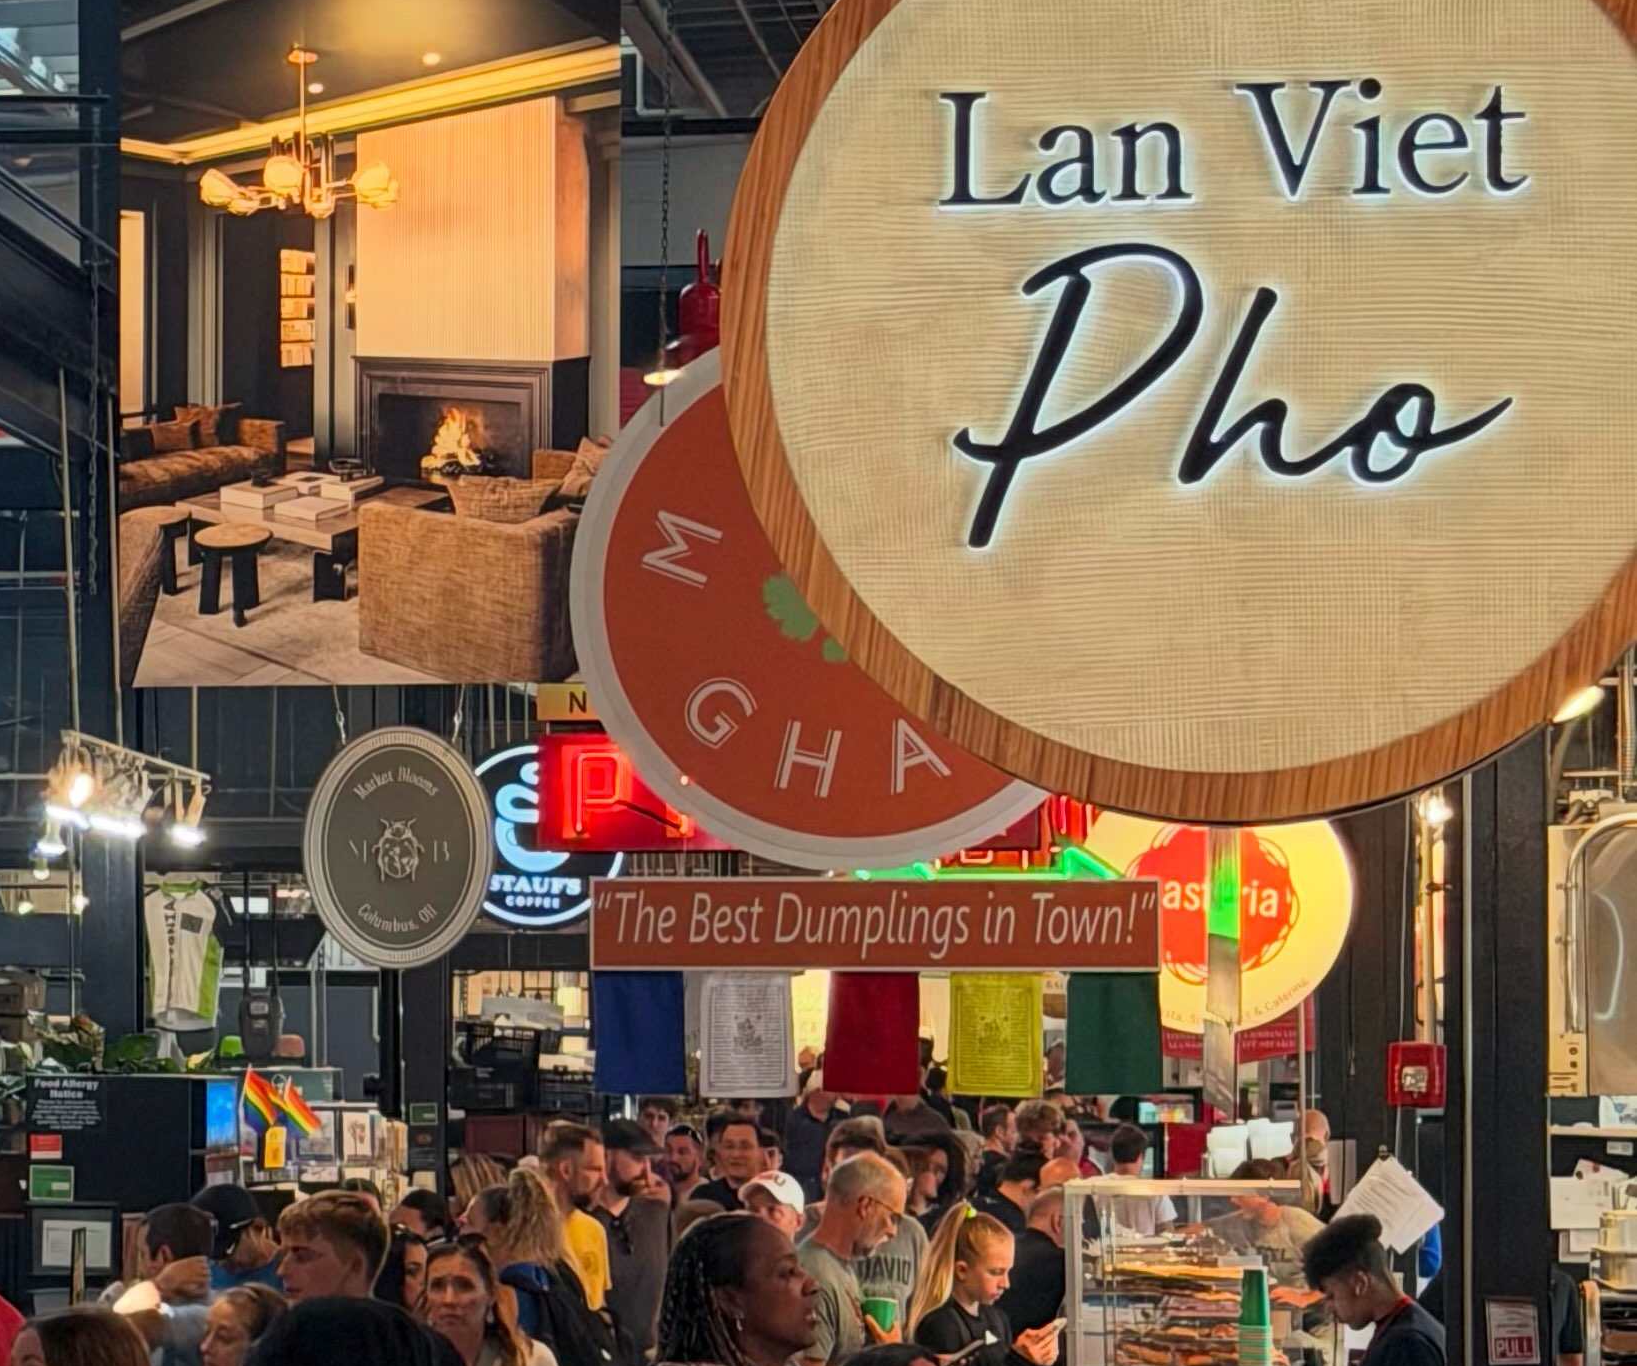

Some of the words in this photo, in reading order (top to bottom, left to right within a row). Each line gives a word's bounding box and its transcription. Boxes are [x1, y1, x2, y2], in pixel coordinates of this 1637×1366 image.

[937, 90, 1194, 209] Lan
[1232, 77, 1530, 201] Viet
[952, 242, 1515, 550] Pho
[683, 675, 952, 799] GHA
[352, 766, 395, 800] Market
[397, 765, 440, 797] Blooms
[504, 894, 561, 909] COFFEE
[689, 891, 763, 944] Best
[774, 890, 970, 960] Dumplings
[982, 889, 1016, 945] in
[34, 1078, 61, 1089] Food
[62, 1078, 100, 1092] Allergy
[49, 1089, 84, 1099] Notice
[1496, 1339, 1533, 1358] PULL
